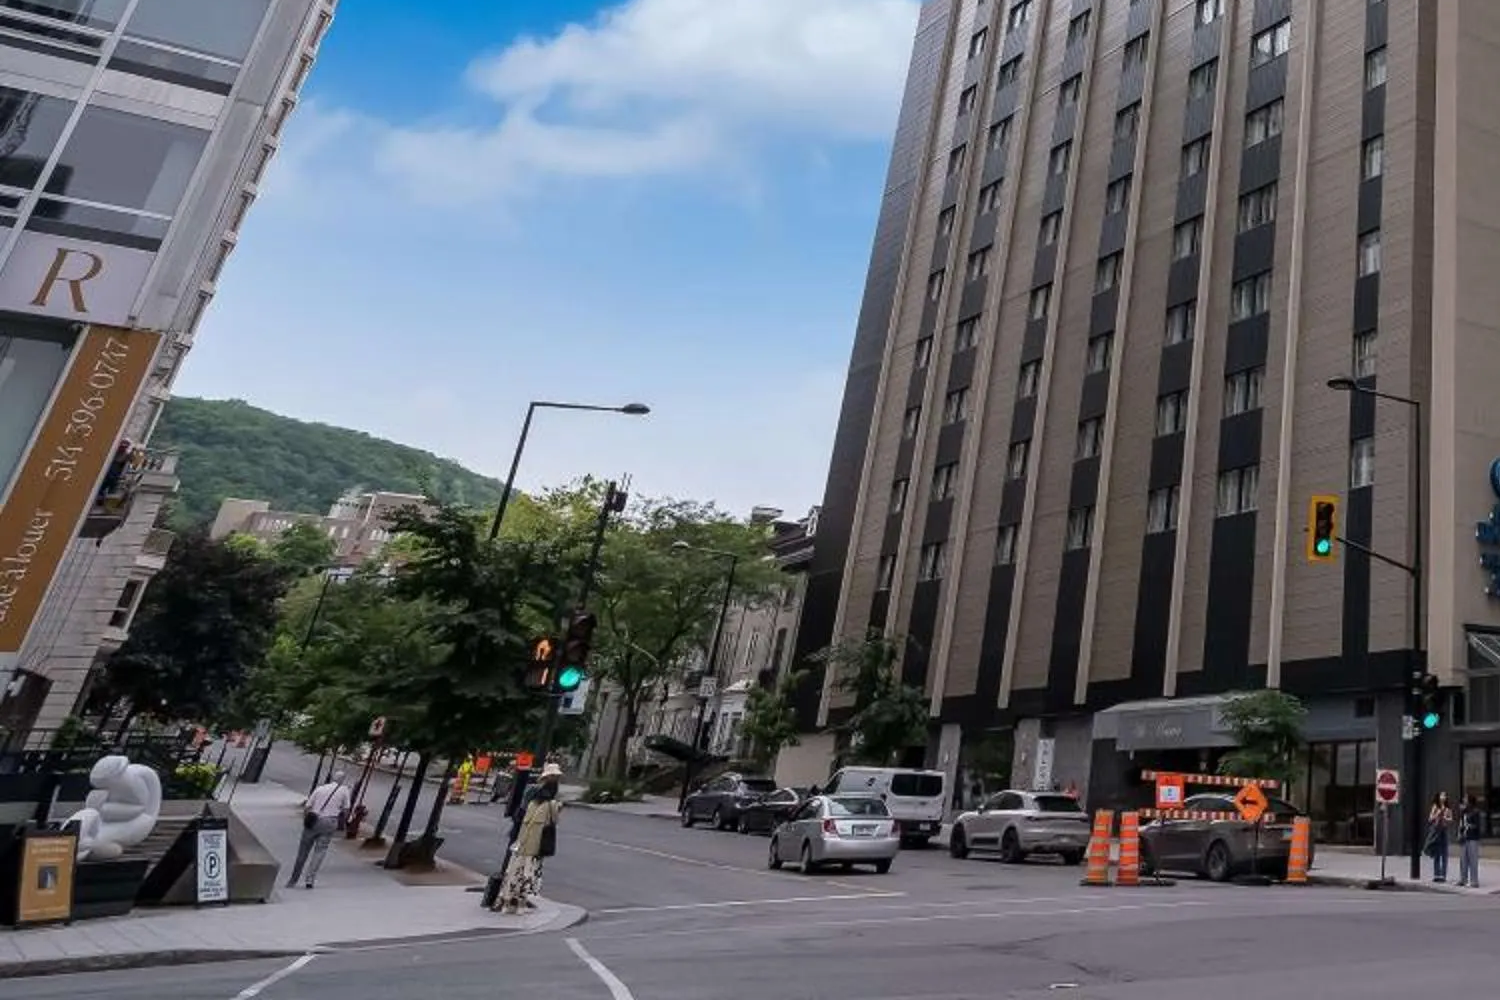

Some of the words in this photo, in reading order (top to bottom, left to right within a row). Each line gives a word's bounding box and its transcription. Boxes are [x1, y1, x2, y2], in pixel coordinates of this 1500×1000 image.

[29, 247, 103, 313] R
[3, 507, 54, 564] louer
[44, 444, 85, 483] 514
